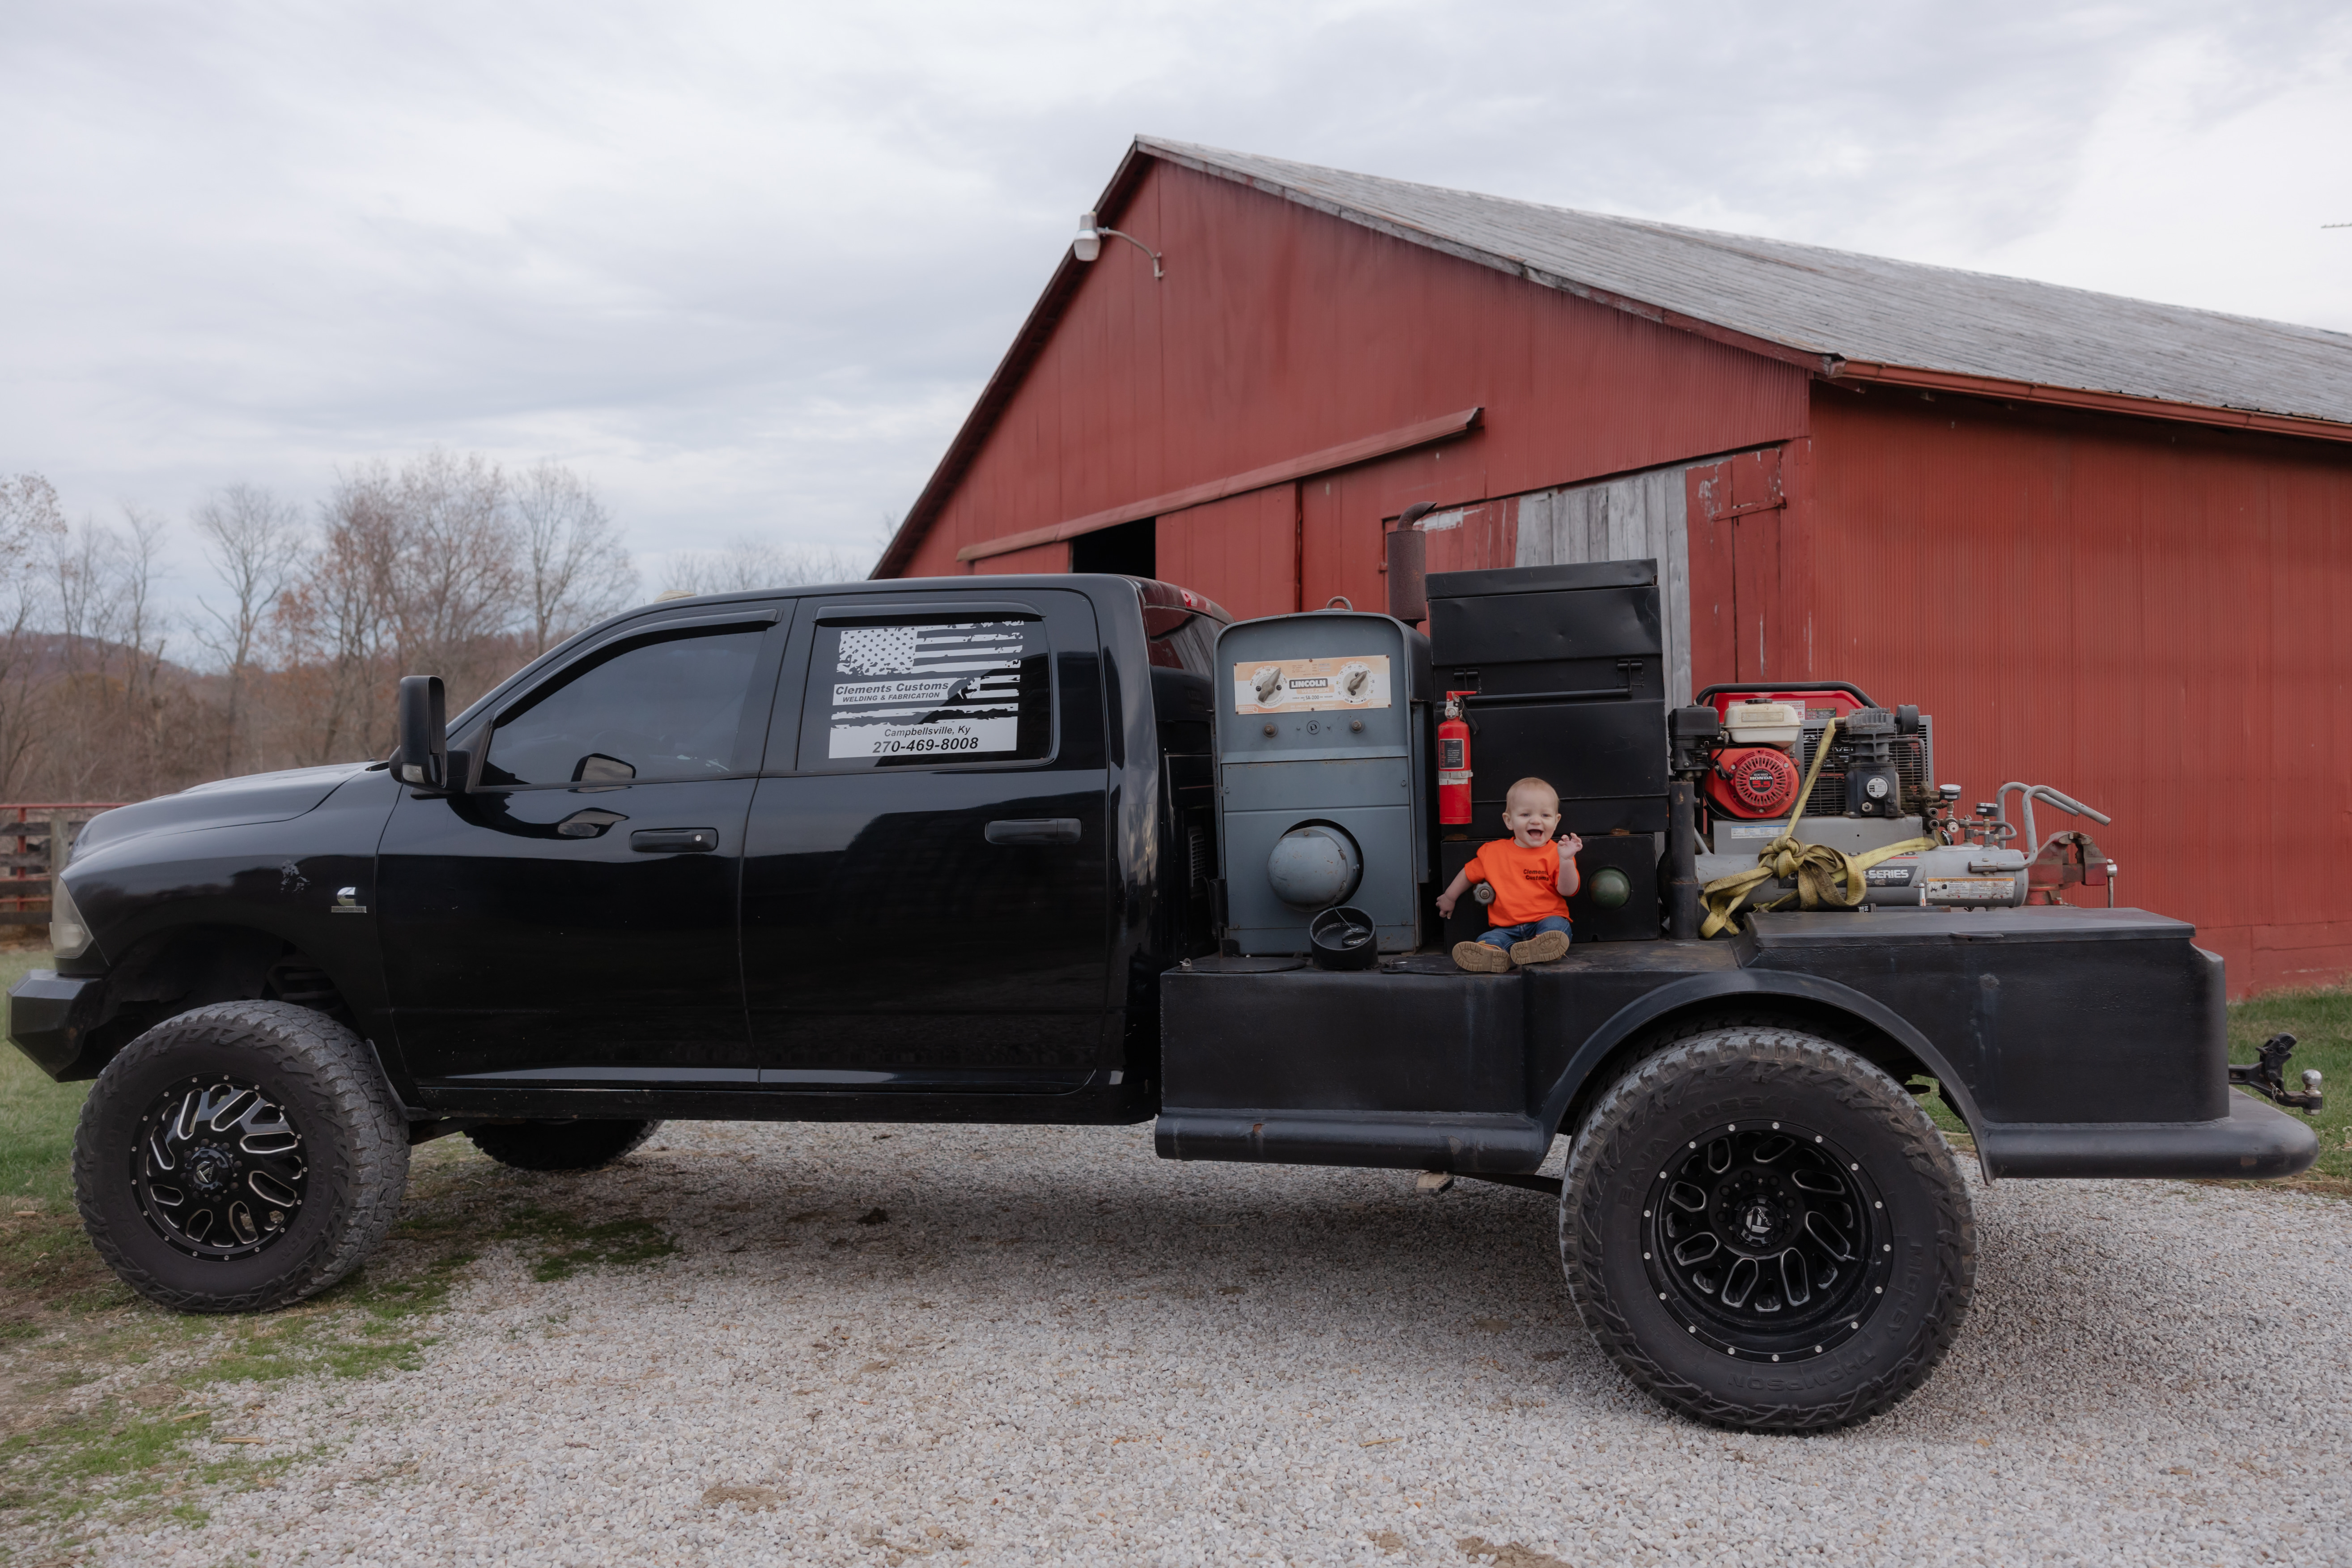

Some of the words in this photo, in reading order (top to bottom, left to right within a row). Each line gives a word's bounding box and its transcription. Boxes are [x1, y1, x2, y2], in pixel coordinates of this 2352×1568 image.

[835, 684, 892, 695] Clements
[896, 683, 949, 692] Customs
[1291, 680, 1326, 688] LINCOLN
[884, 727, 954, 737] Campbellsville,
[958, 726, 971, 735] Ky
[872, 737, 979, 753] 270-469-8008
[1868, 869, 1909, 879] SERIES
[1618, 1138, 1670, 1206] BAJA
[1678, 1096, 1762, 1130] BOSS
[1758, 1207, 1771, 1227] FUEL
[1885, 1244, 1923, 1340] MICKEY
[1728, 1349, 1876, 1391] THOMPSON
